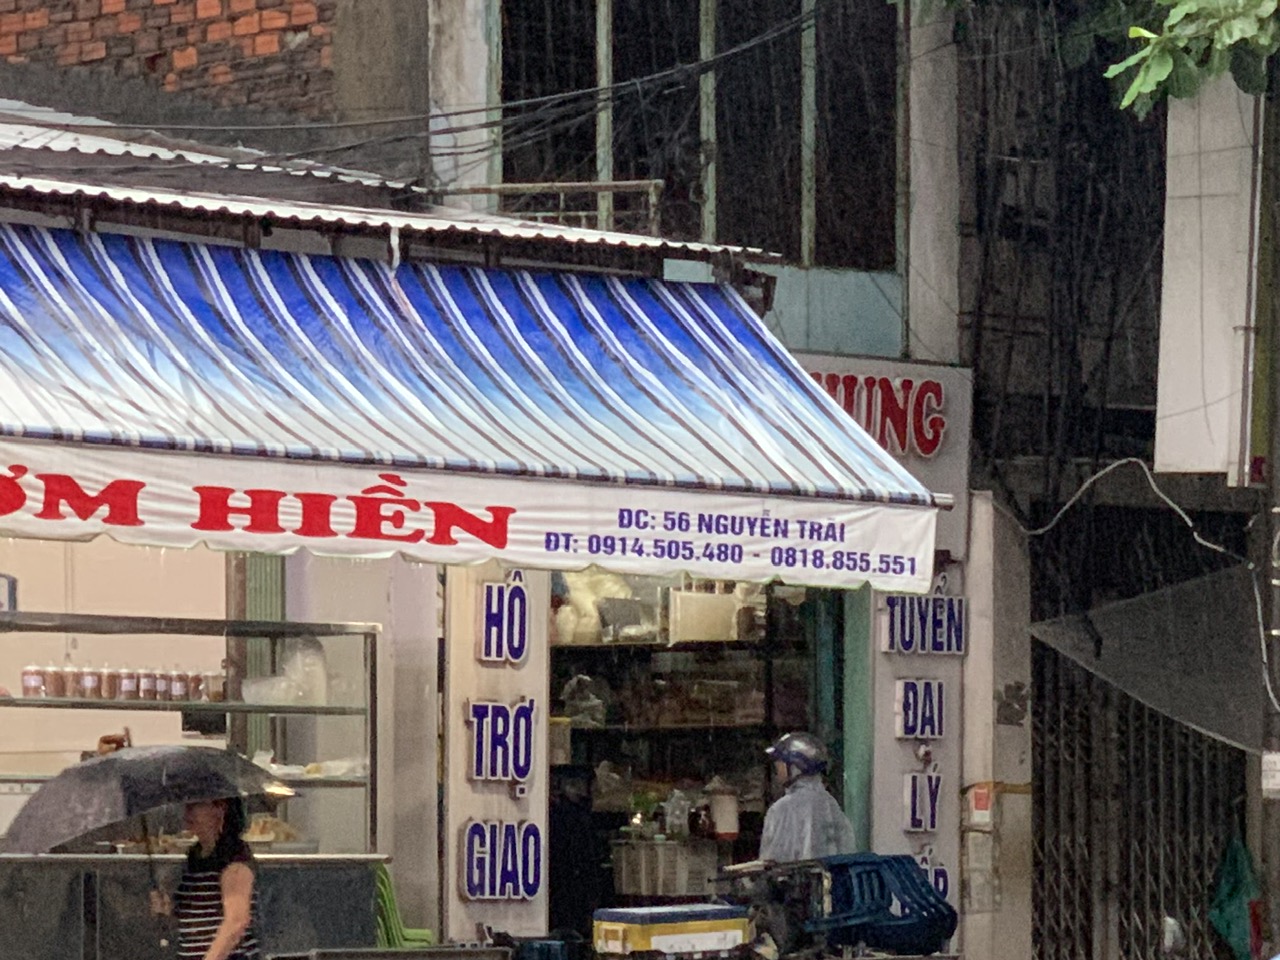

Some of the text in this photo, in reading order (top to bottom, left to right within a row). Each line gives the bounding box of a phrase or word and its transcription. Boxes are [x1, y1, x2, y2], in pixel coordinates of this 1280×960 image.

[191, 473, 517, 550] HIỀN
[617, 507, 657, 531] ĐC:
[662, 511, 692, 533] 56
[544, 531, 579, 554] ĐT:
[587, 534, 744, 566] 0914.505.480
[770, 546, 918, 577] 0818.855.551
[471, 698, 535, 798] TRỢ
[911, 763, 941, 831] LÝ
[466, 821, 541, 899] GIAO
